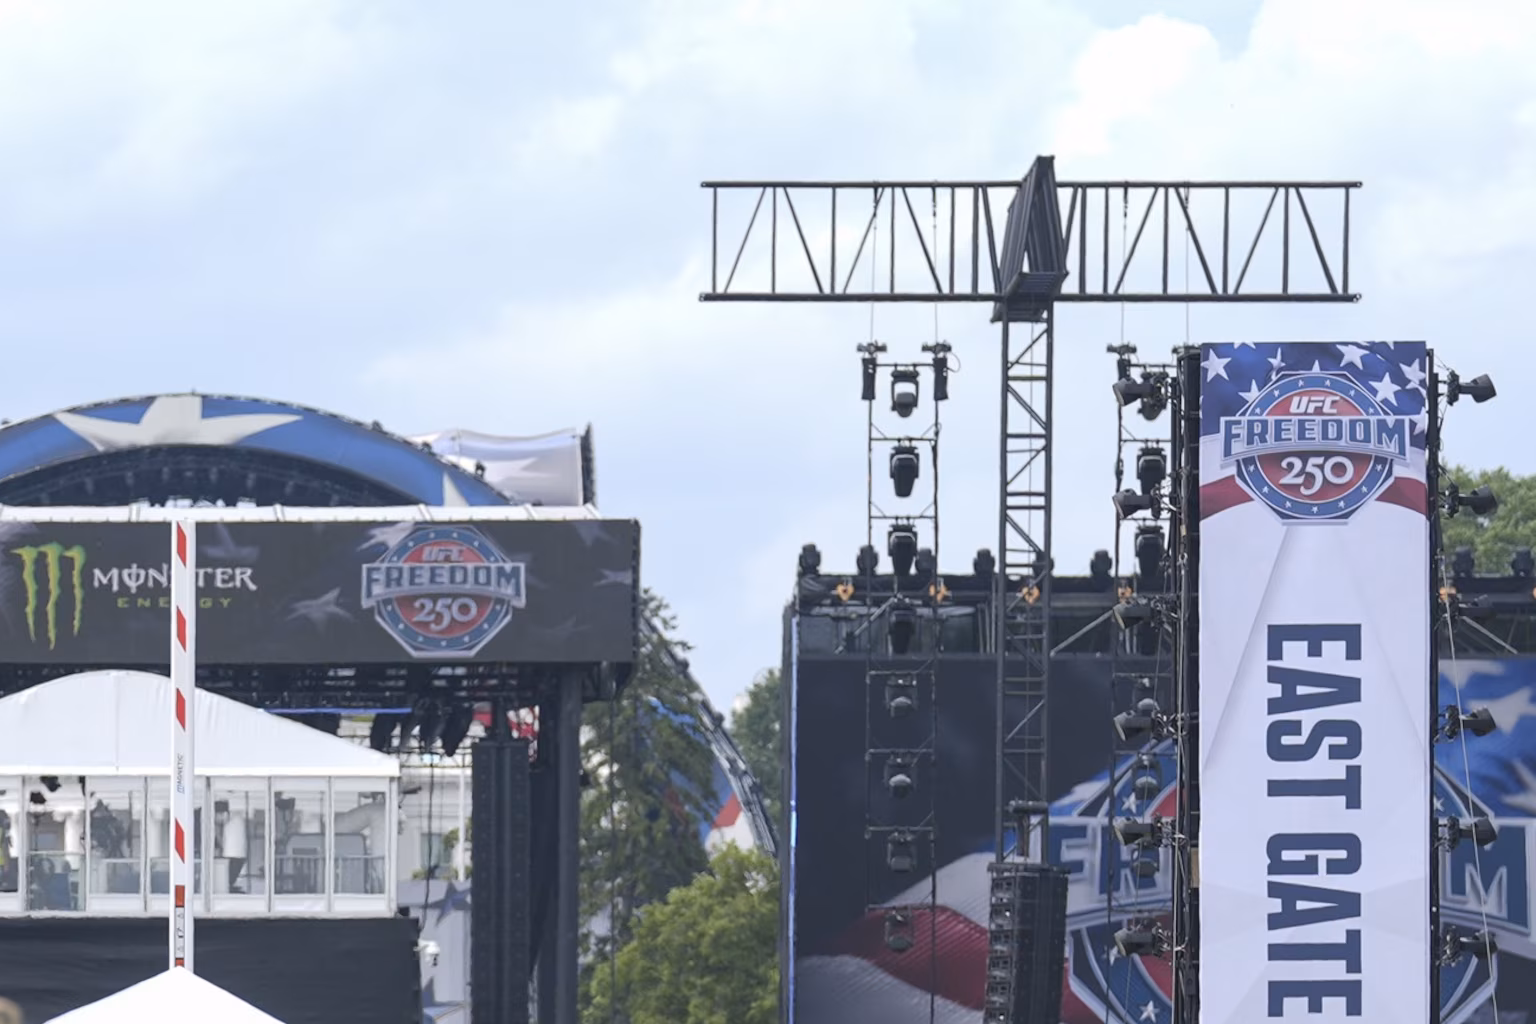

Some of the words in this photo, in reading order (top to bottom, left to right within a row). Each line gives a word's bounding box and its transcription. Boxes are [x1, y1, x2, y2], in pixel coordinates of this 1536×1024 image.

[1289, 395, 1340, 414] UFC
[1223, 418, 1407, 460] FREEDOM
[1278, 455, 1354, 495] 250
[92, 563, 257, 594] MONTER
[366, 564, 521, 600] FREEDOM
[117, 597, 232, 608] ENEGY
[413, 597, 478, 632] 250
[1265, 623, 1362, 811] EAST
[1265, 832, 1362, 1018] GATE
